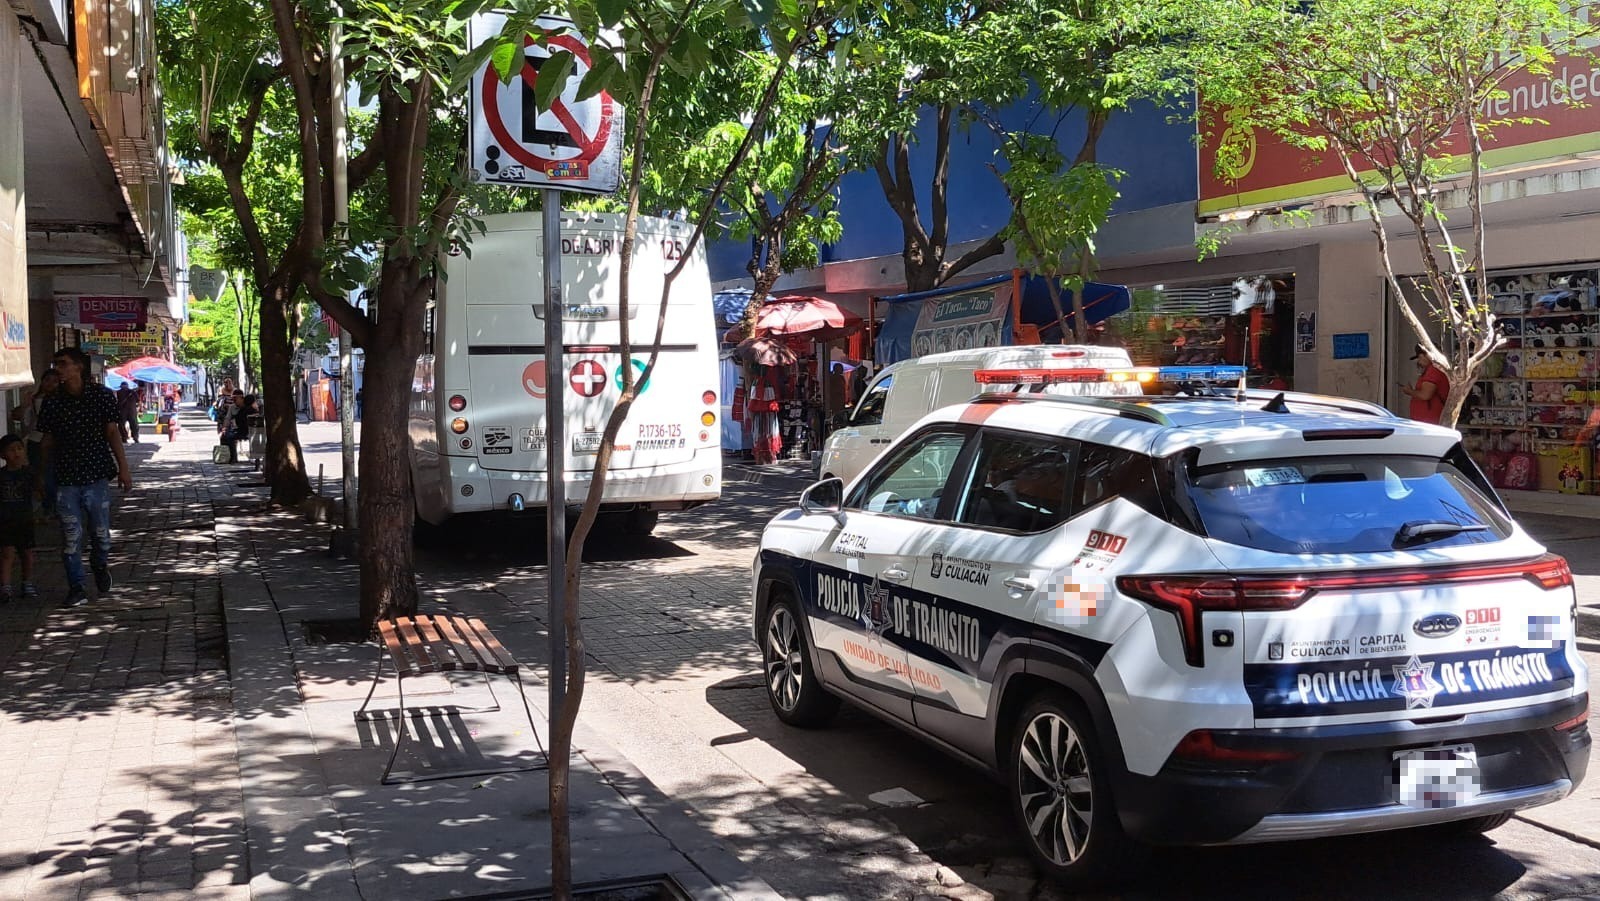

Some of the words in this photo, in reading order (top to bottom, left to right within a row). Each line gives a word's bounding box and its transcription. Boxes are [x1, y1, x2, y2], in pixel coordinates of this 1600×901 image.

[660, 239, 683, 260] 125
[82, 300, 141, 312] DENTISTA
[839, 532, 869, 549] CAPITAL
[1087, 532, 1124, 552] 911
[817, 573, 860, 620] POLICÍA
[893, 595, 911, 639] DE
[912, 597, 980, 663] TRÁNSITO
[1466, 608, 1500, 624] 911
[1291, 639, 1341, 647] AYUNTAMIENTO
[1360, 634, 1407, 646] CAPITAL
[1370, 644, 1407, 653] BIENESTAR
[843, 639, 876, 665] UNIDAD
[878, 655, 891, 671] DE
[891, 659, 942, 689] VIALIDAD
[1297, 661, 1389, 704] POLICÍA
[1440, 662, 1471, 694] DE
[1468, 651, 1553, 691] TRÁNSITO
